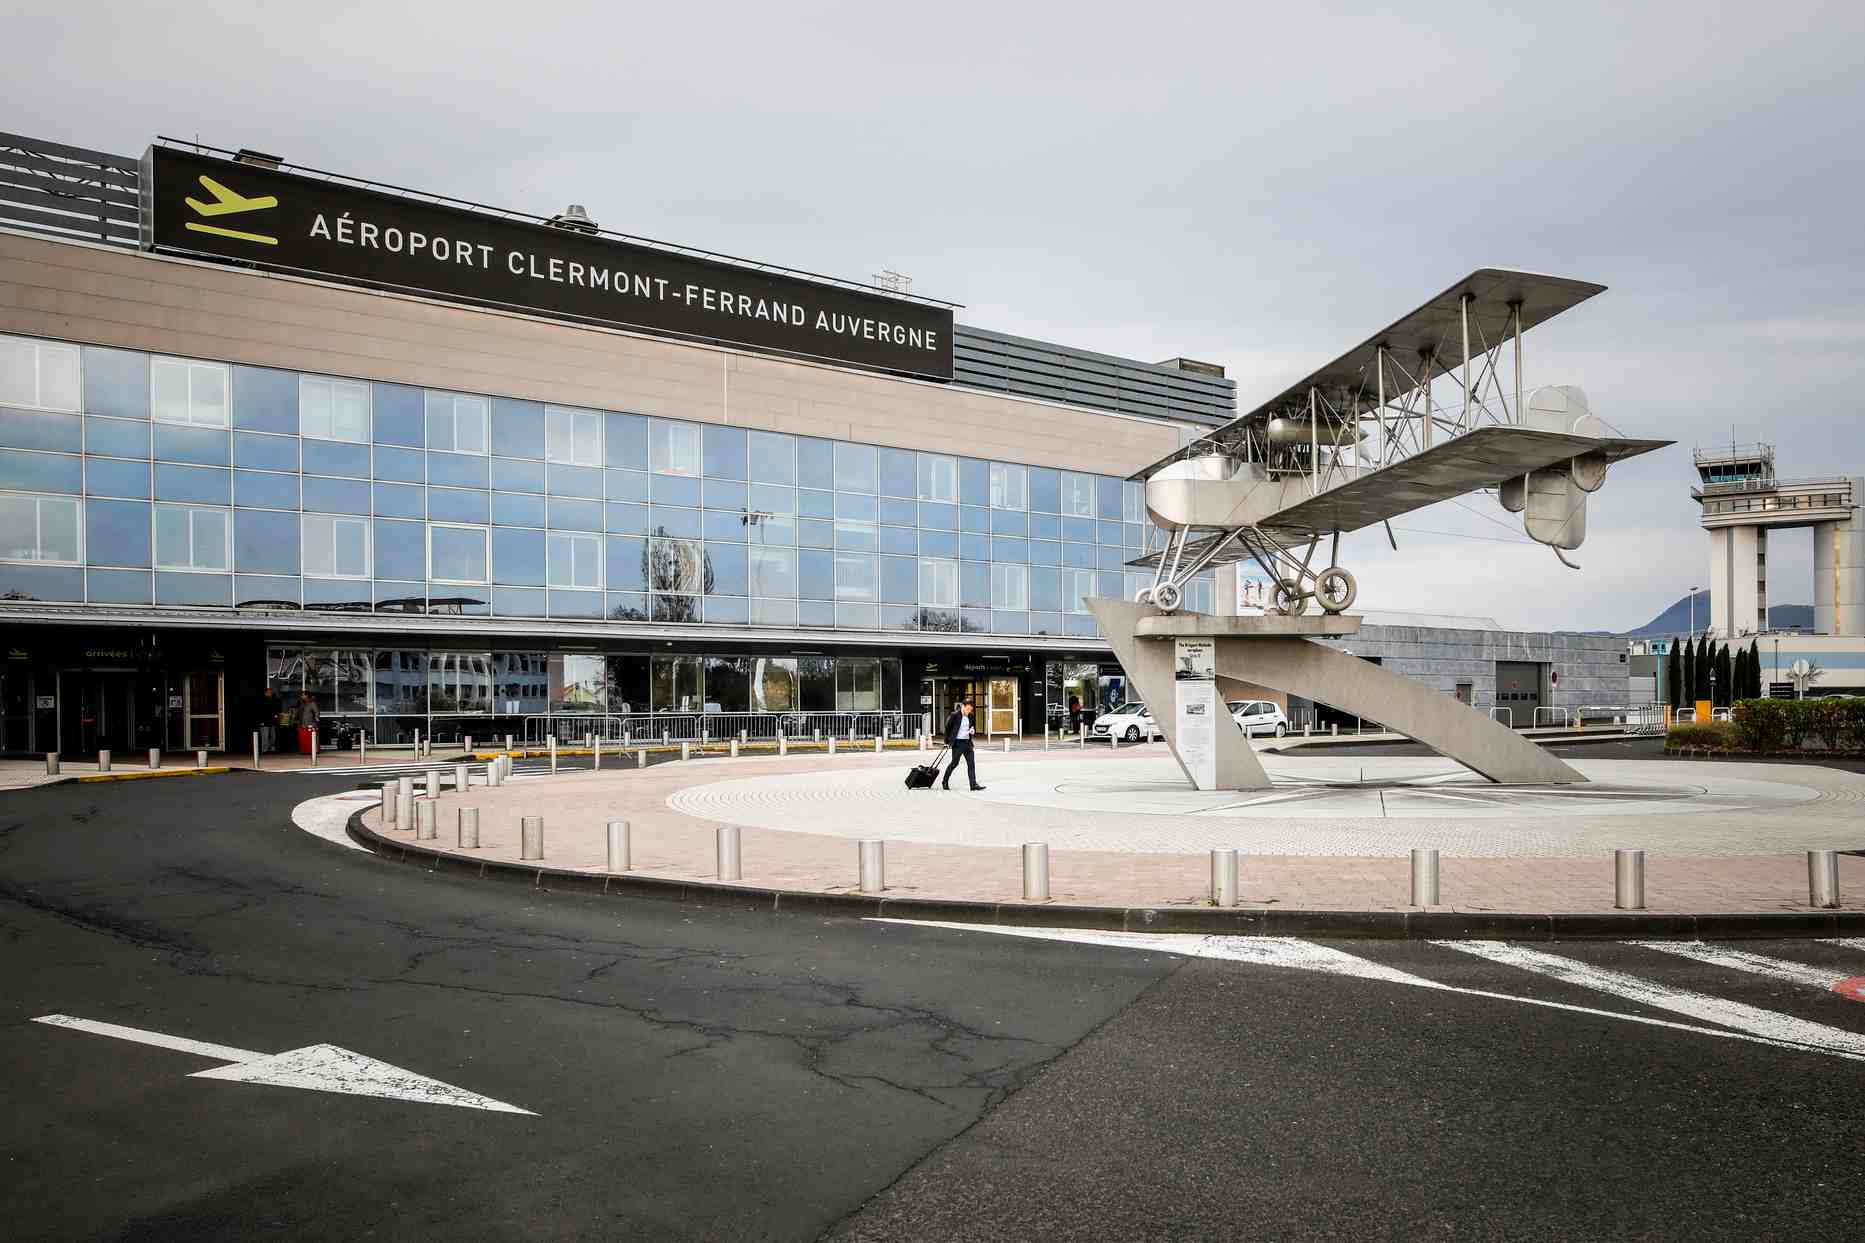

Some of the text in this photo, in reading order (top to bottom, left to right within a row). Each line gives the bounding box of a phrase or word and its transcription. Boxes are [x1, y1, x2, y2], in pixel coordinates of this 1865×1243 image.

[309, 211, 938, 352] AÉROPORT CLERMONT-FERRAND AUVERGNE
